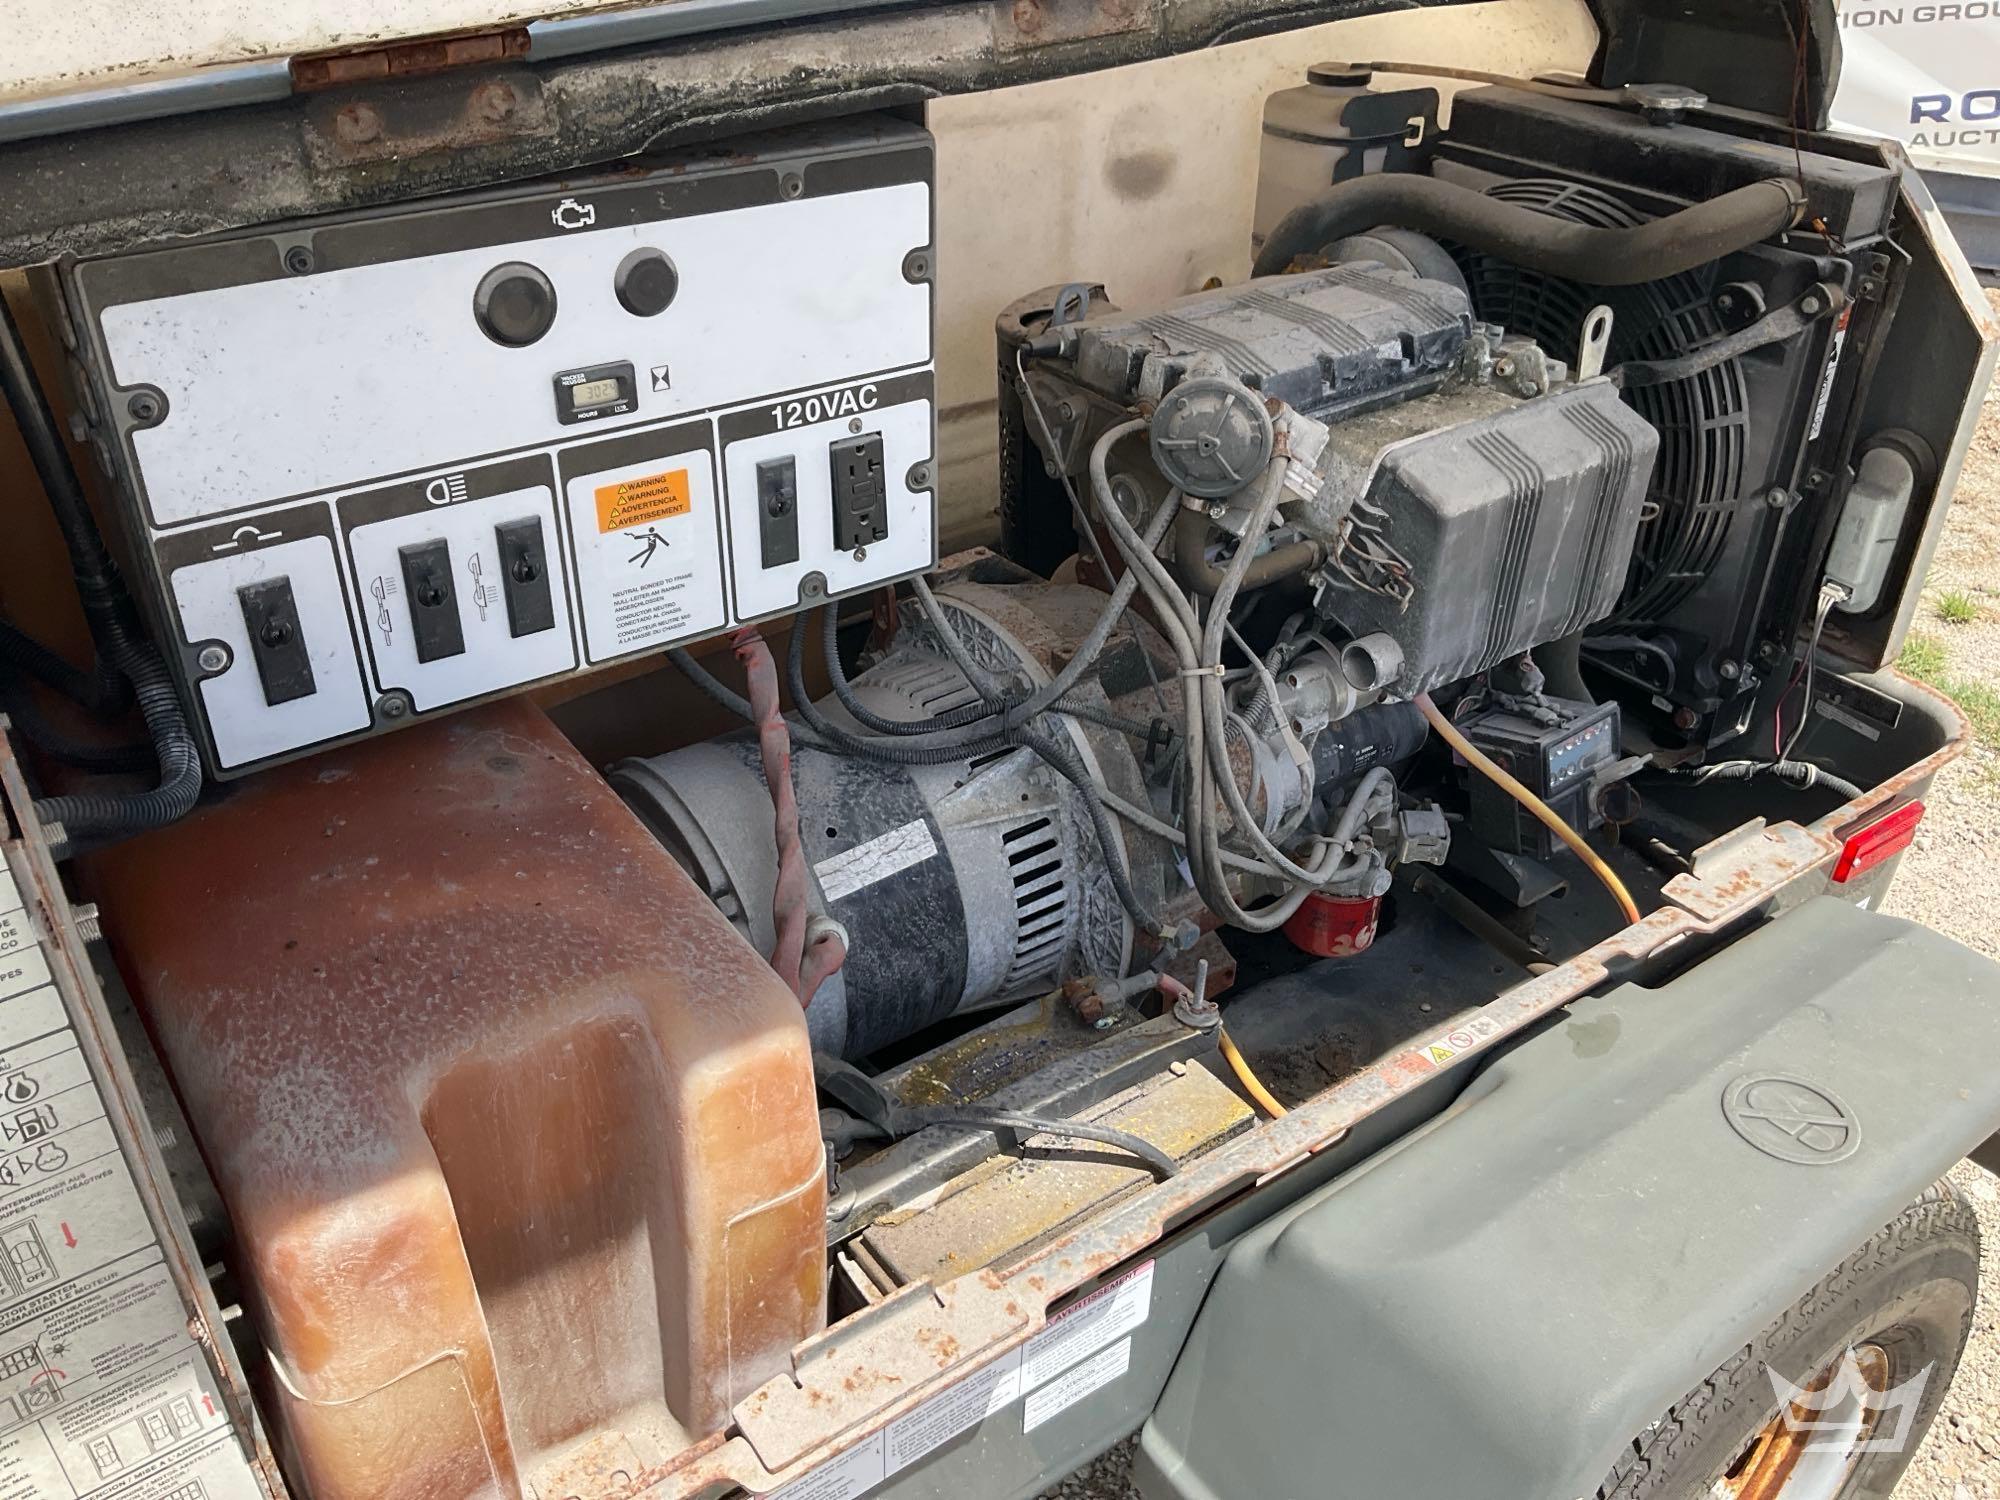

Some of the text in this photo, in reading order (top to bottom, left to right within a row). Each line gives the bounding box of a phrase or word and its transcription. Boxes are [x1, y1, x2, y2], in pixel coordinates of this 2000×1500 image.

[1838, 8, 1904, 29] ION
[577, 410, 598, 420] HOURS
[771, 384, 878, 430] 120VAC
[628, 476, 667, 491] WARNING
[628, 487, 670, 502] WARNUNG
[618, 505, 684, 527] AVERTISSEMENT
[621, 496, 678, 515] ADVERTENCIA
[612, 587, 638, 598] NEUTRAL
[640, 580, 665, 591] BONDED
[674, 573, 693, 582] FRAME
[614, 596, 665, 614] ANGESCHLOSSEN
[616, 601, 677, 622] CONDUCTOR NEUTRO
[616, 615, 653, 629] CONECTADO
[617, 623, 658, 638] CONDUCTEUR
[658, 616, 680, 627] NEUTRE
[632, 631, 652, 641] MASSE
[1, 928, 18, 939] DE
[26, 1271, 47, 1283] OFF
[59, 1291, 73, 1302] LE
[75, 1271, 119, 1294] MOTEUR
[29, 1282, 77, 1309] STARTEN
[1056, 1270, 1138, 1321] AVERTISSEMENT
[43, 1295, 102, 1324] AUTO HEATING
[51, 1315, 100, 1342] CHAUFFAGE
[56, 1402, 89, 1421] CIRCUIT
[90, 1381, 134, 1404] BREAKERS
[133, 1464, 158, 1480] MISE
